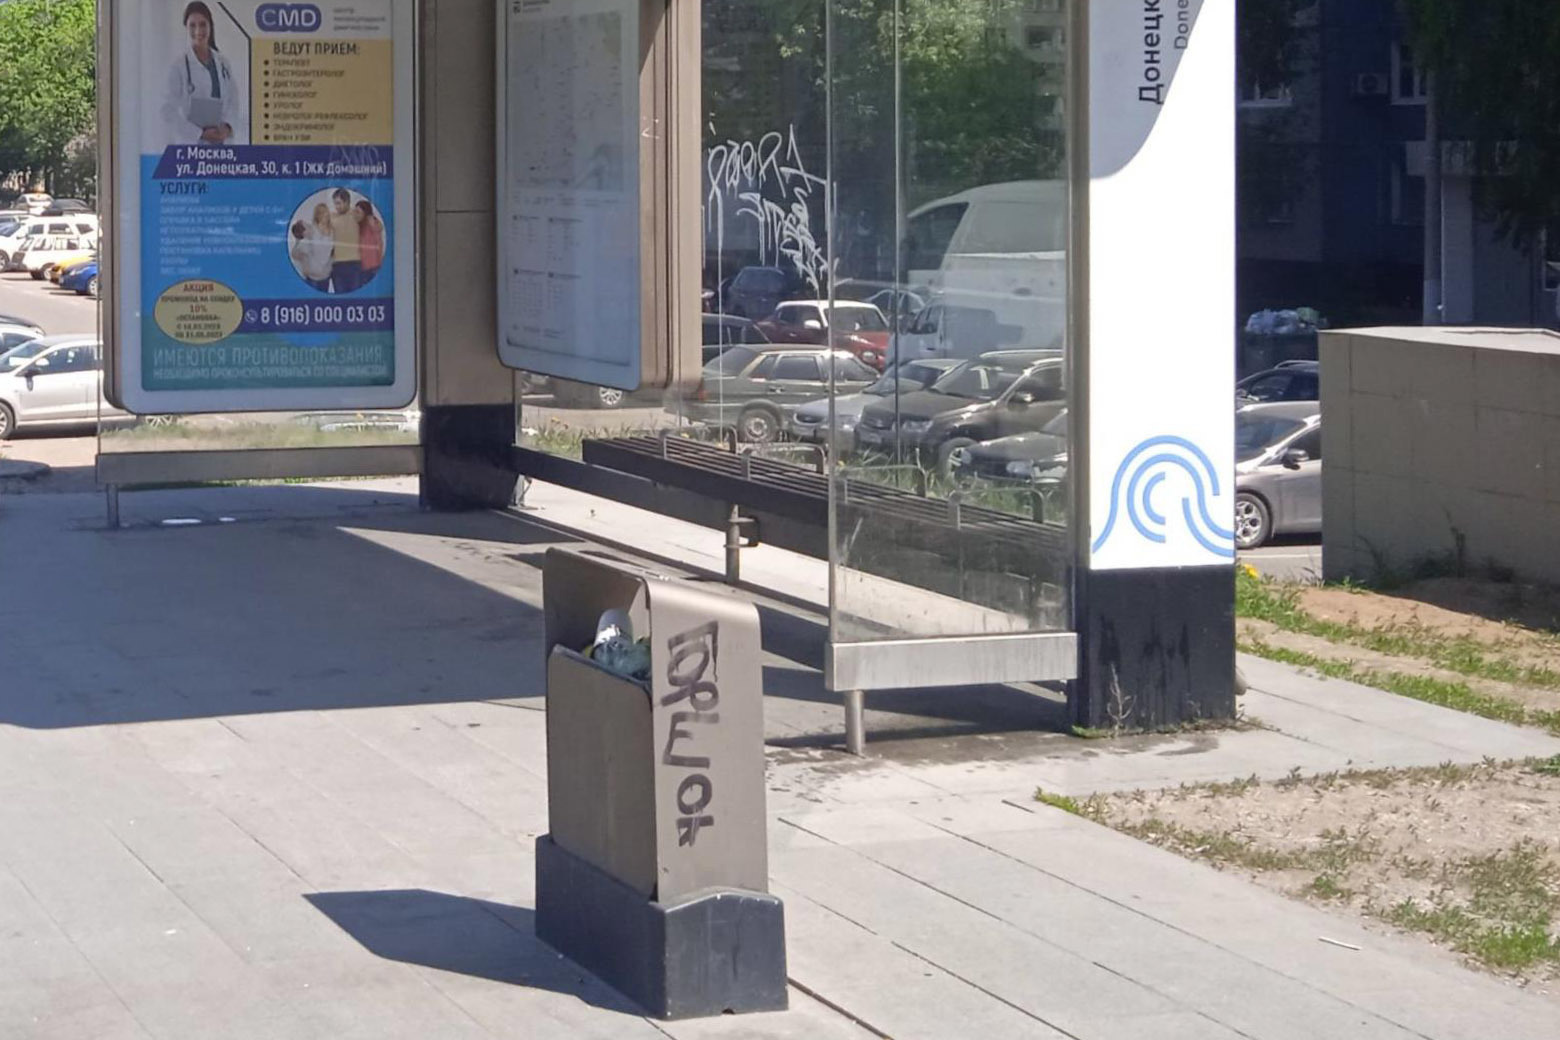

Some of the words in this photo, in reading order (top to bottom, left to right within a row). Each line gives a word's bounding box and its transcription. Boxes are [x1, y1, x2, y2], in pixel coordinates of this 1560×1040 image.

[261, 8, 317, 27] CMD
[273, 41, 311, 55] ВЕДУТ
[176, 148, 185, 160] г.
[187, 146, 237, 162] Москва,
[176, 163, 194, 177] ул.
[196, 161, 259, 176] Донецкая,
[261, 161, 279, 175] 30,
[282, 163, 293, 174] к.
[295, 161, 300, 174] 1
[303, 160, 325, 176] (ЖК
[260, 307, 270, 324] 8
[275, 304, 310, 326] (916)
[314, 306, 342, 323] 000
[347, 306, 364, 322] 03
[368, 305, 385, 322] 03
[153, 346, 226, 367] ИМЕЮТСЯ
